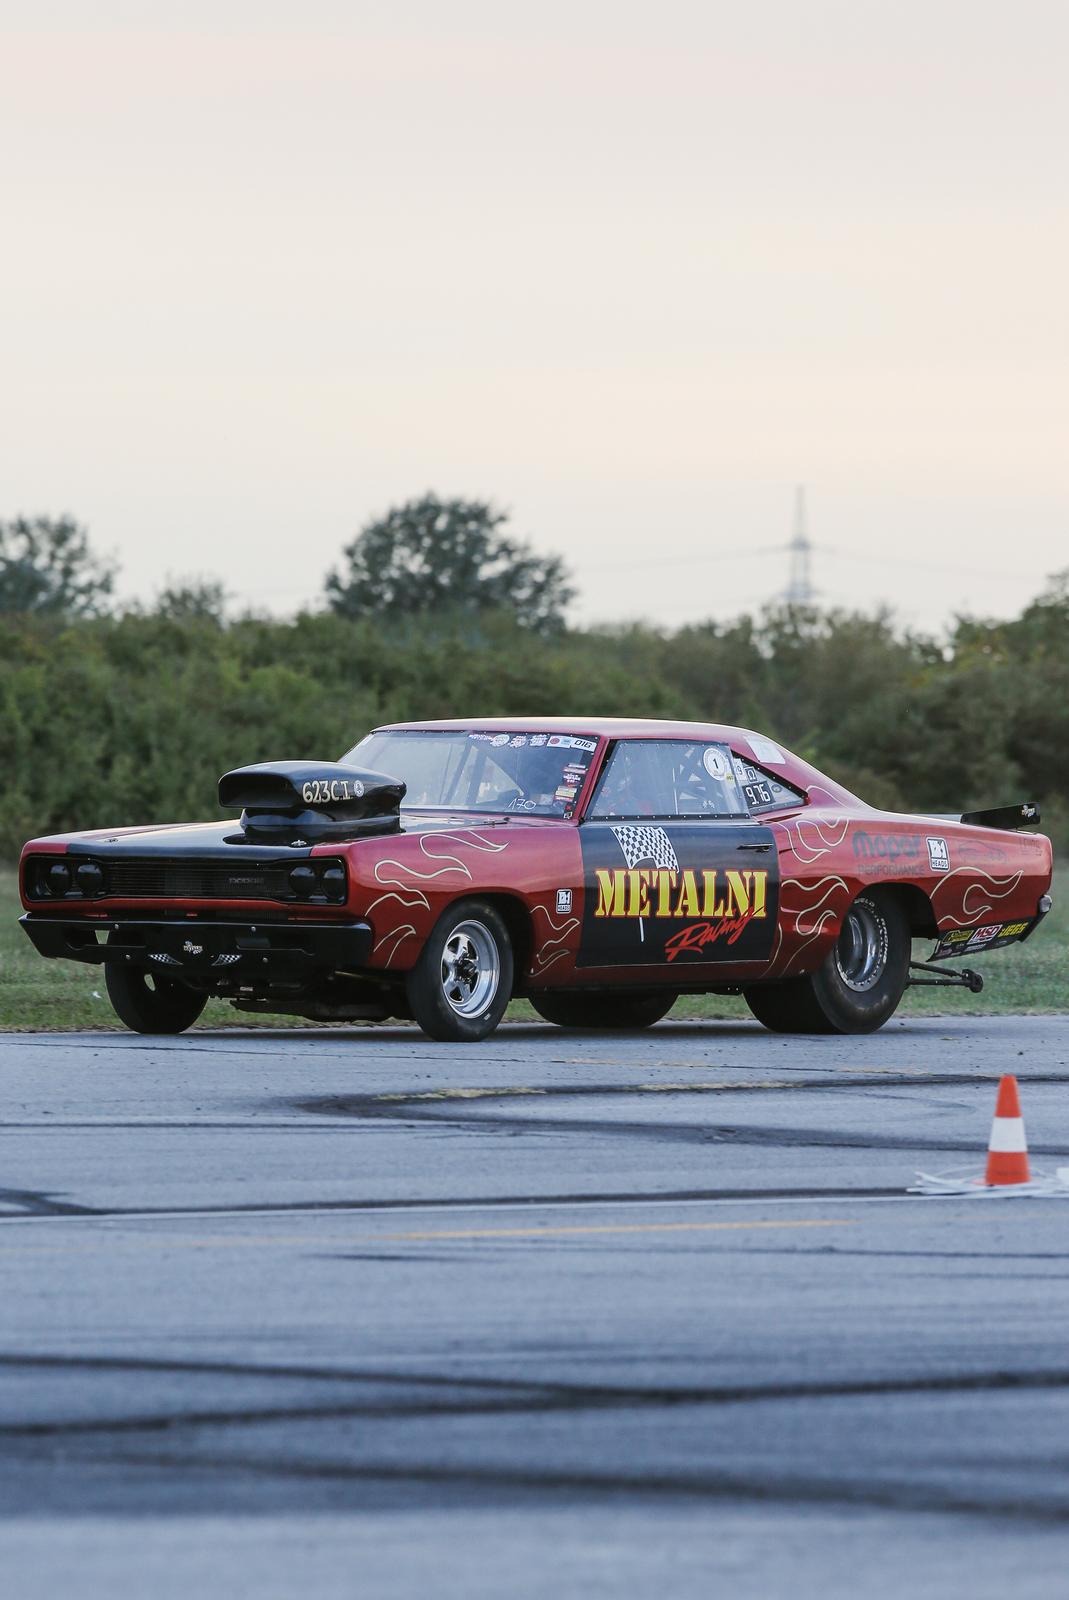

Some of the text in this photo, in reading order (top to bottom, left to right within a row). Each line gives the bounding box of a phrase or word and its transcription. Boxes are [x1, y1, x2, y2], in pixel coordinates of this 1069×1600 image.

[594, 868, 768, 918] METALNI
[858, 864, 925, 875] PERFORMANCE
[664, 907, 758, 962] Racing
